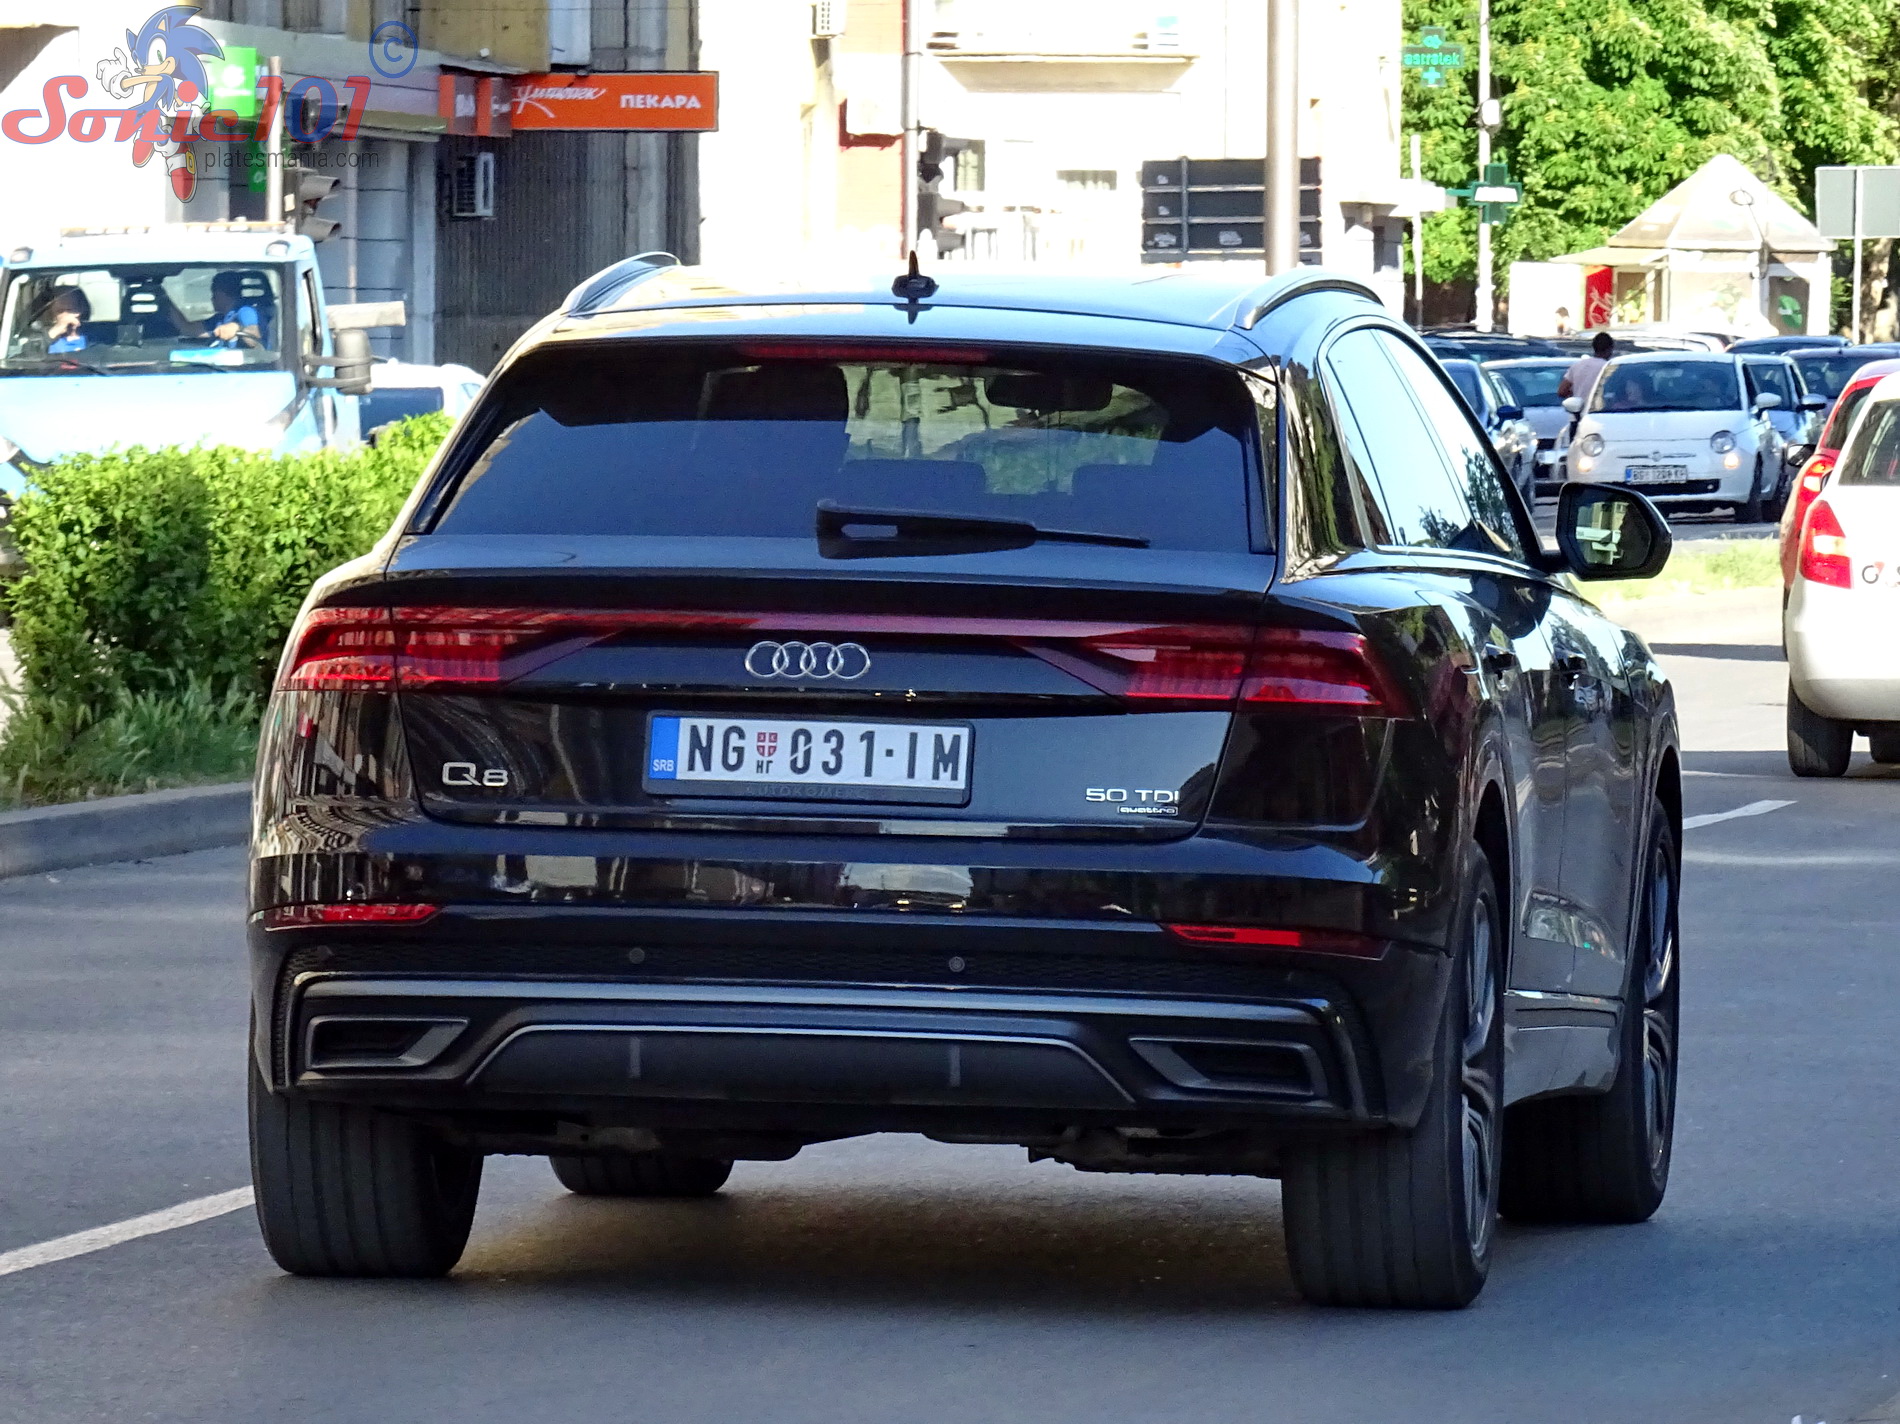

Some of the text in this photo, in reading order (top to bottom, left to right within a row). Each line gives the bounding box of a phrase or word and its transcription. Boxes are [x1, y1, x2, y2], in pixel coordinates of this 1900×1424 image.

[619, 94, 702, 109] ПЕКАРА
[687, 724, 747, 773] NG
[652, 759, 674, 772] SRB
[442, 761, 508, 787] Q8
[1085, 788, 1179, 804] 50 TDI
[1119, 806, 1176, 815] quattro
